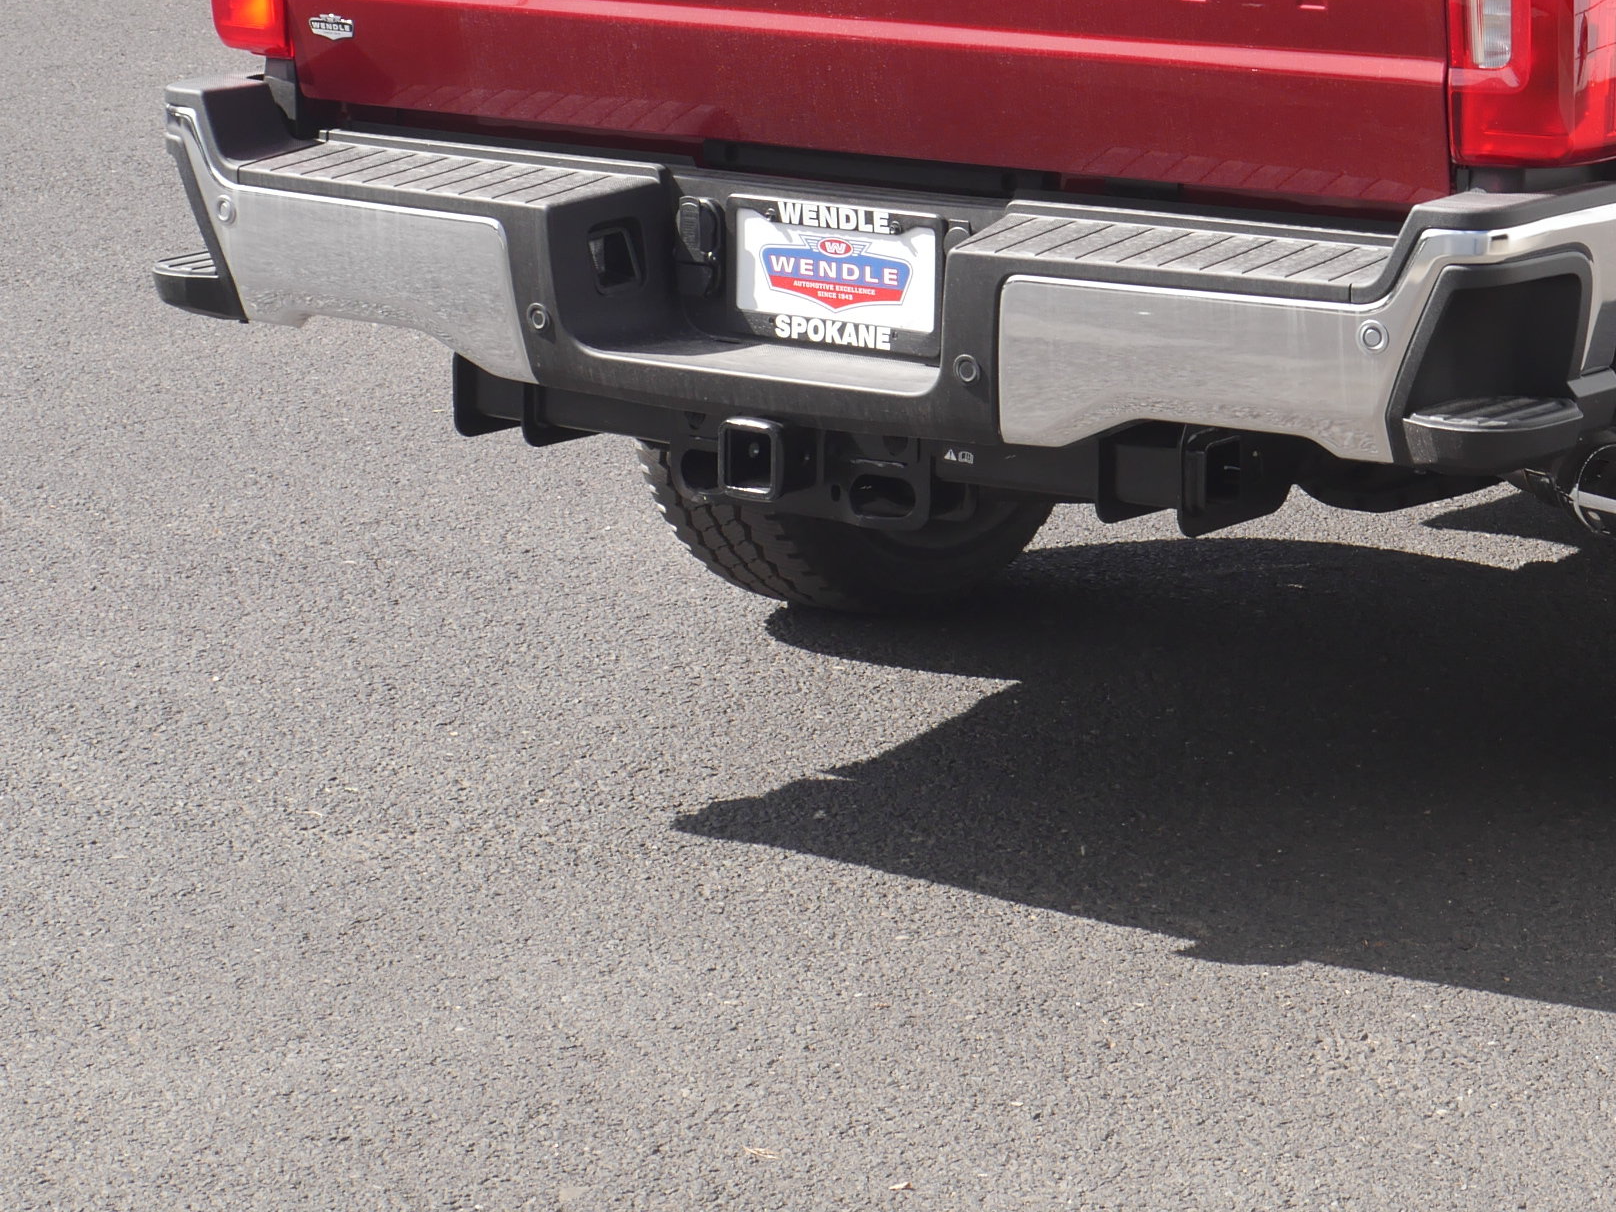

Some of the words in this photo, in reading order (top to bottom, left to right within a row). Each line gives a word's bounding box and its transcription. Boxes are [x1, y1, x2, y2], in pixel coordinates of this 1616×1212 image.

[311, 21, 350, 32] WENDLE
[777, 201, 890, 235] WENDLE
[769, 255, 898, 286] WENDLE
[793, 280, 834, 291] AUTOMOTIVE
[835, 285, 876, 296] EXCELLENCE
[817, 290, 836, 299] SINCE
[774, 314, 891, 351] SPOKANE
